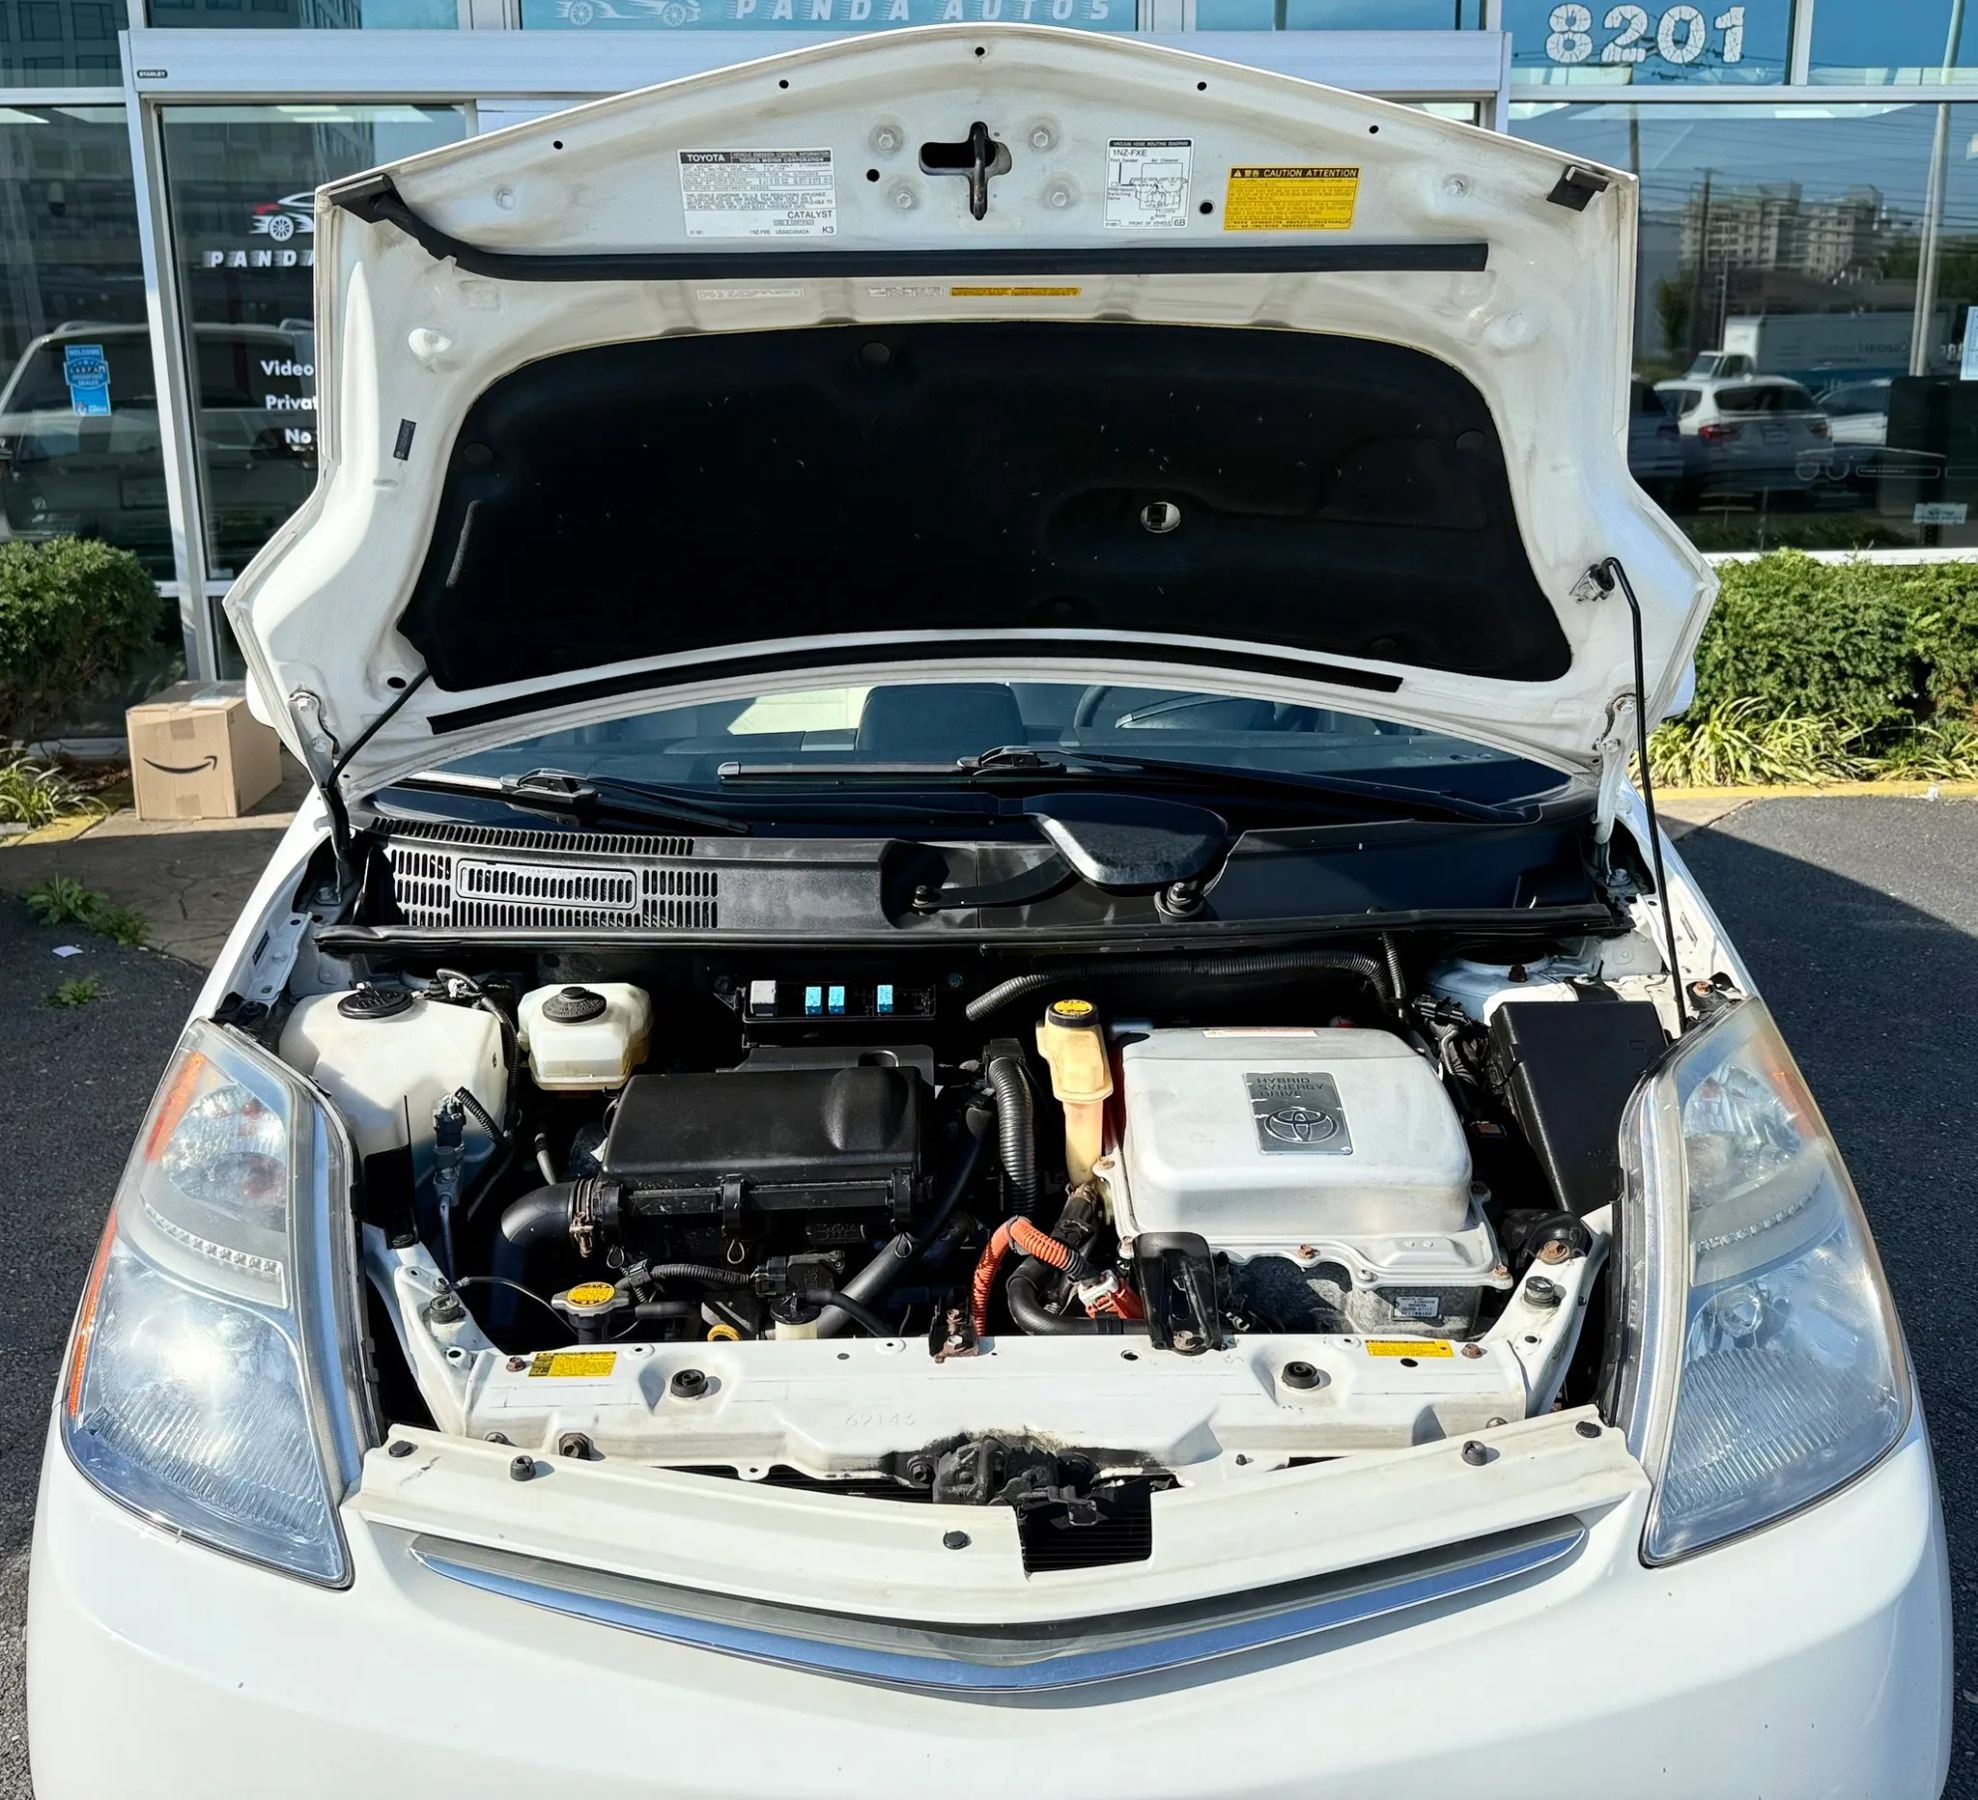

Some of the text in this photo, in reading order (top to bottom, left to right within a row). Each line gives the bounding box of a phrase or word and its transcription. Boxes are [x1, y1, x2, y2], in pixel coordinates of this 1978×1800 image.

[729, 0, 1109, 21] PANDA AUTOS
[1545, 3, 1745, 64] 8201
[1113, 149, 1148, 157] 1NZ-FXE
[687, 154, 725, 162] TOYOTA
[1263, 169, 1357, 177] CAUTION ATTENTION
[787, 210, 832, 219] CATALYST
[1174, 219, 1186, 227] 6B
[822, 226, 834, 234] K3
[260, 360, 315, 376] Video
[284, 428, 312, 444] No
